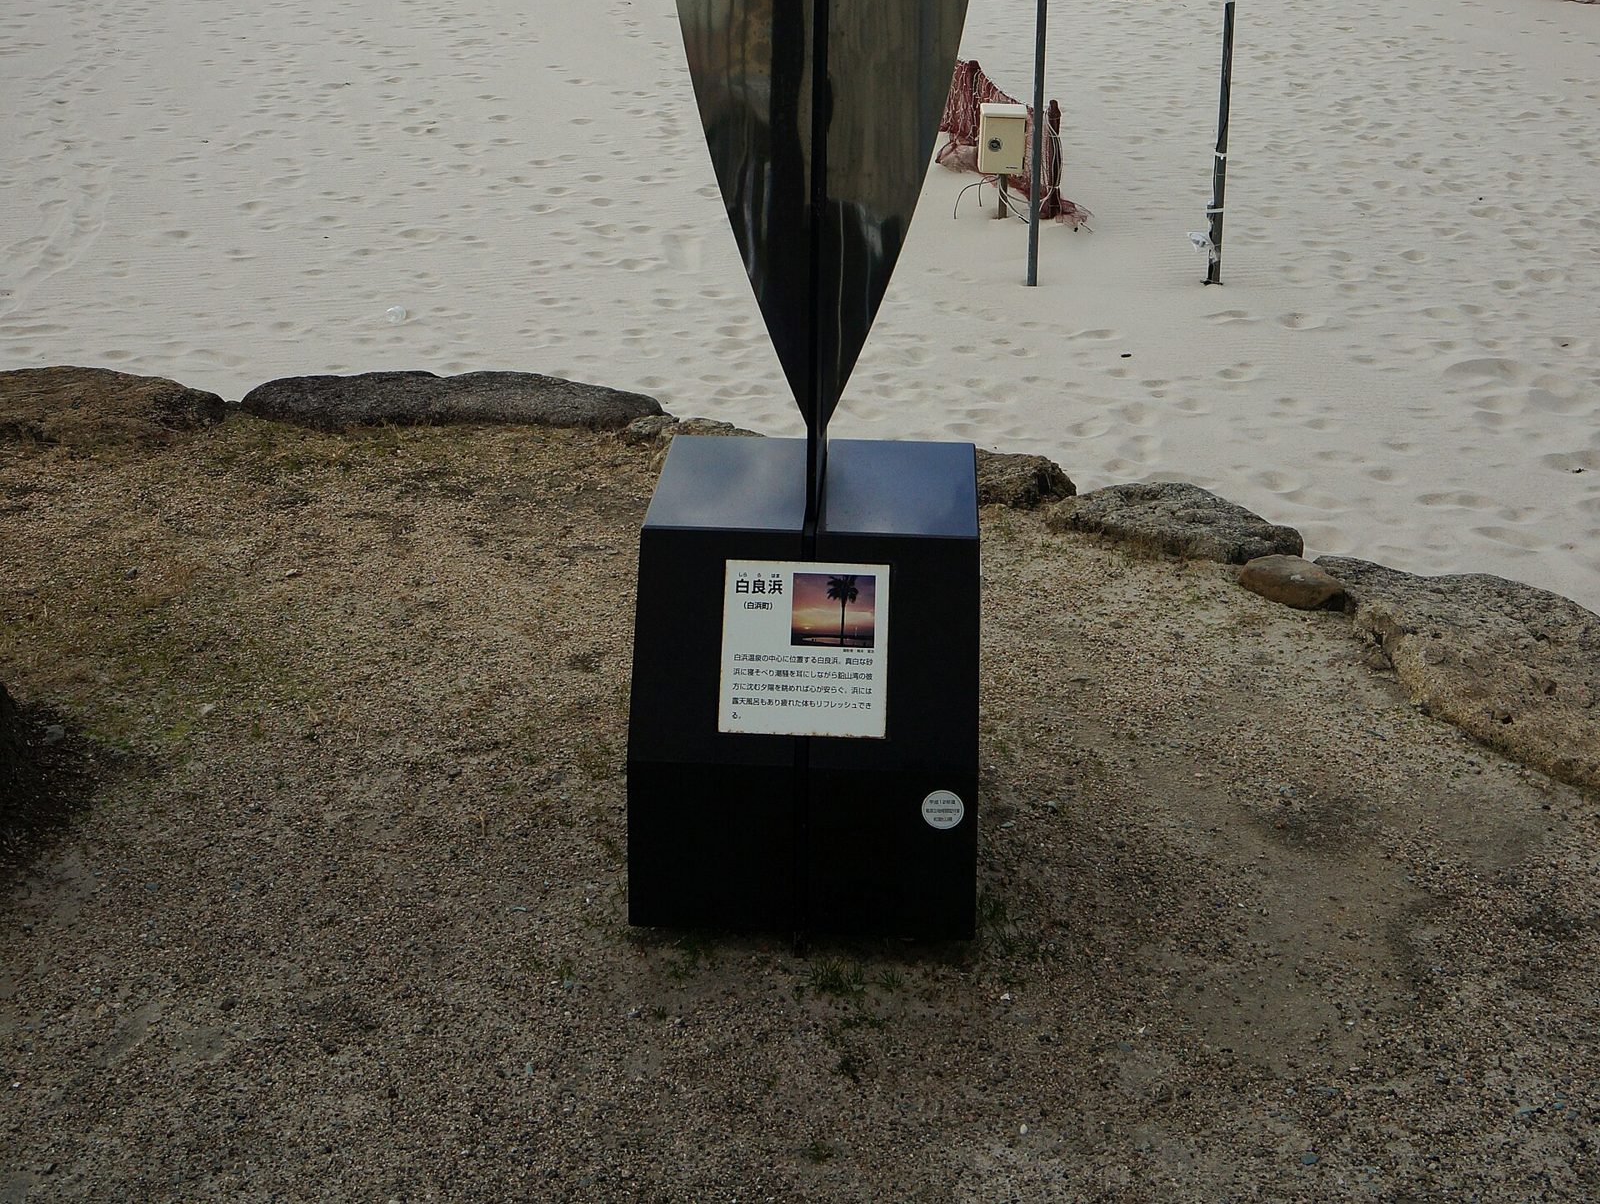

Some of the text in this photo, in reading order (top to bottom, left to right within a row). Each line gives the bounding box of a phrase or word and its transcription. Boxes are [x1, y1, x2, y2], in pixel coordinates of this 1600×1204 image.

[735, 578, 783, 595] 白良浜
[743, 601, 773, 610] (白浜町)
